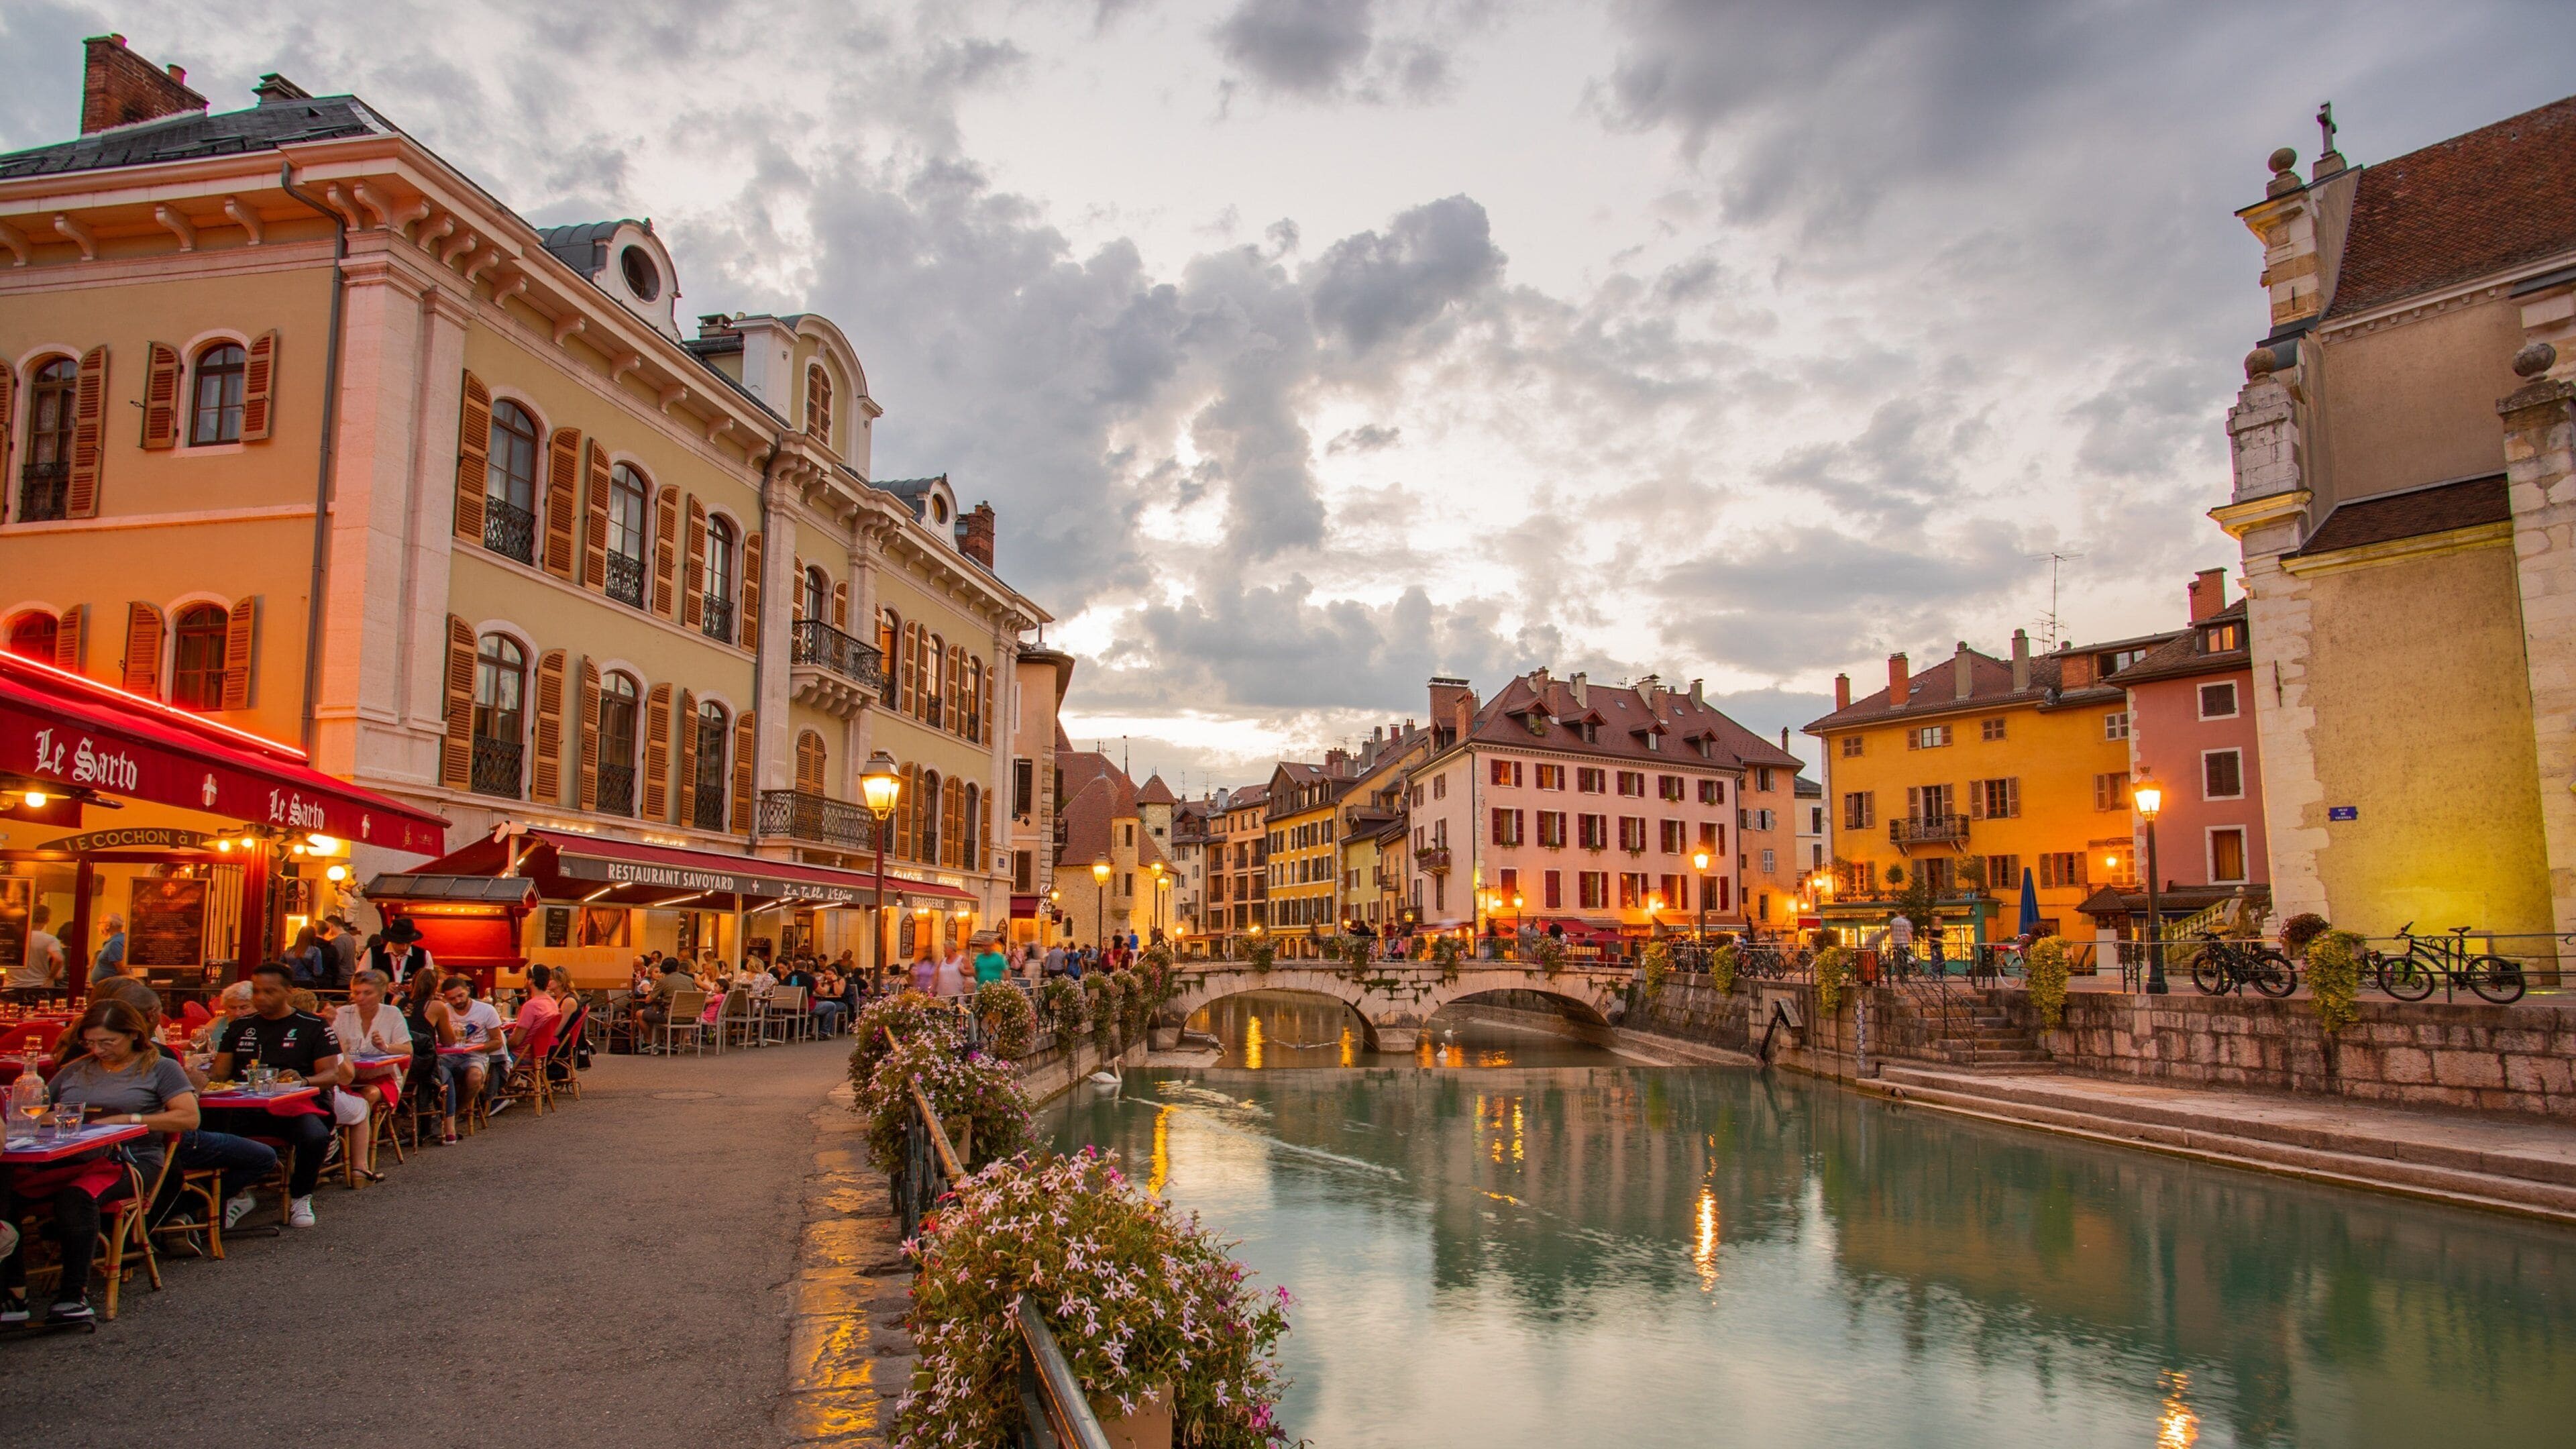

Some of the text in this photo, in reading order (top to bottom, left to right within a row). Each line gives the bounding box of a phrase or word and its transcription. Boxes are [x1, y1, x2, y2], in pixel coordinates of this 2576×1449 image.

[35, 728, 138, 790] Le Sarto
[269, 788, 325, 830] Le Sarto
[92, 830, 170, 847] COCHON
[608, 863, 734, 891] RESTAURANT SAVOYARD
[783, 883, 799, 896] La
[801, 886, 824, 899] Table
[912, 896, 971, 911] BRASSERIE PIZZA
